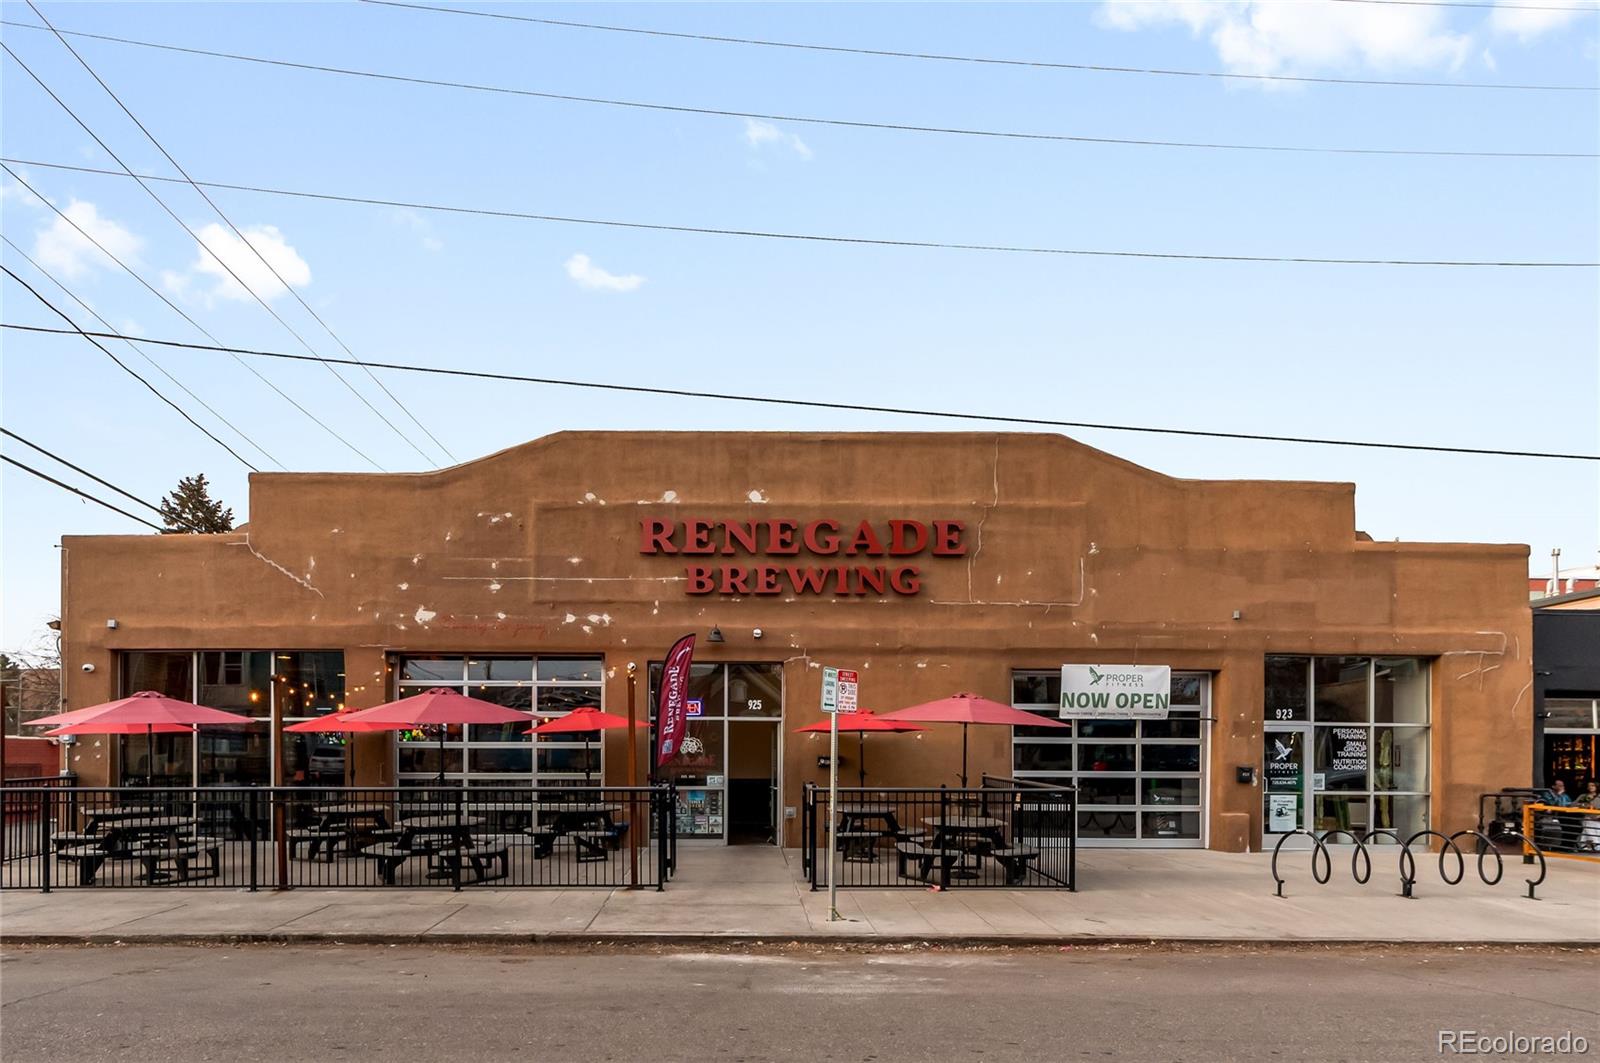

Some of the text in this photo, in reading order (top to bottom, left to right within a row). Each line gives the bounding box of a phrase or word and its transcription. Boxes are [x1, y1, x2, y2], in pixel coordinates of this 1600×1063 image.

[639, 518, 967, 555] RENEGADE
[685, 564, 922, 595] BREWING
[1106, 673, 1144, 682] PROPER
[664, 665, 680, 735] RENEGADE
[747, 699, 762, 710] 925
[1062, 692, 1169, 709] NOW OPEN
[1275, 708, 1293, 720] 923
[1270, 762, 1298, 770] PROPER
